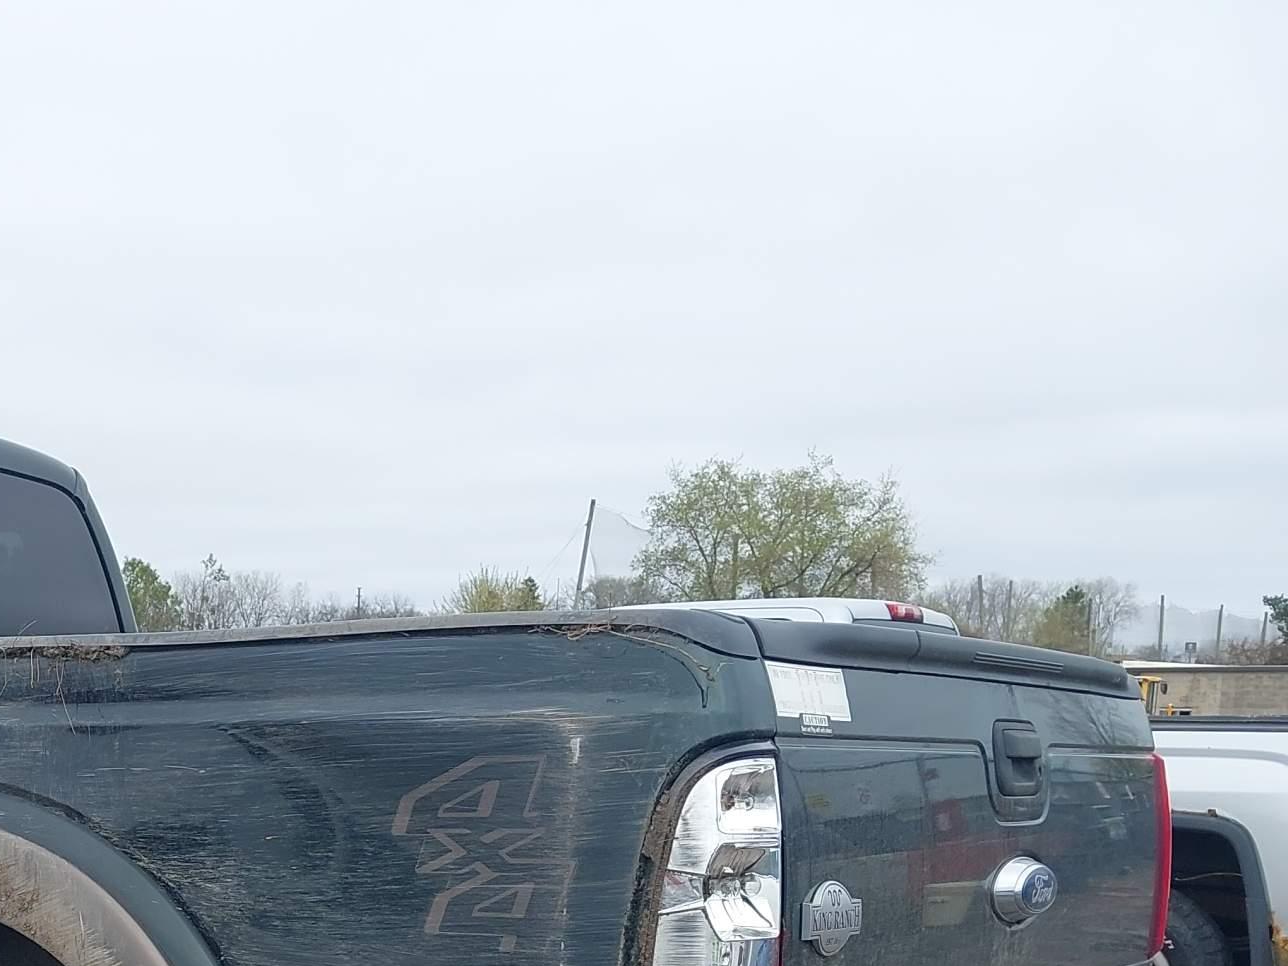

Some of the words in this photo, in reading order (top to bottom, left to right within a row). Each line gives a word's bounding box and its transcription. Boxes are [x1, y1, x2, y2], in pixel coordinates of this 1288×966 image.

[1032, 874, 1053, 904] Ford
[812, 909, 833, 931] KING
[834, 903, 860, 930] RANCH
